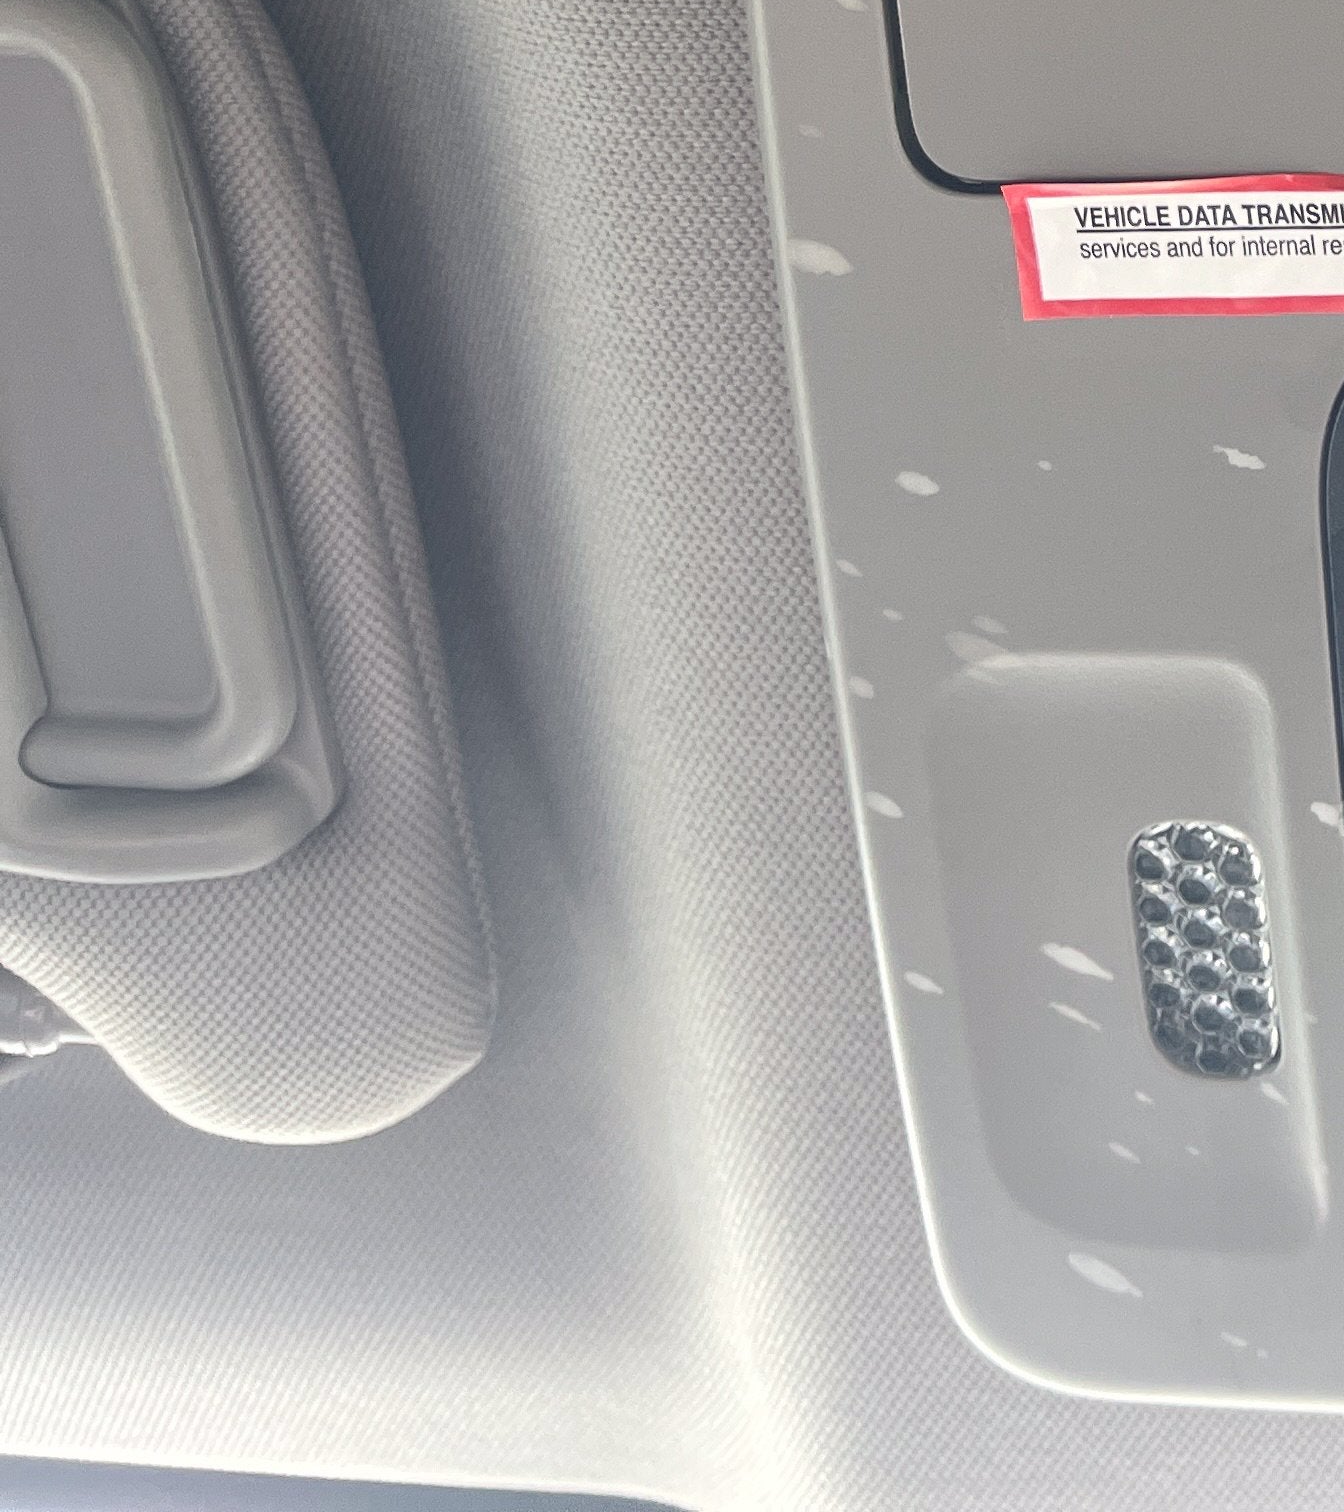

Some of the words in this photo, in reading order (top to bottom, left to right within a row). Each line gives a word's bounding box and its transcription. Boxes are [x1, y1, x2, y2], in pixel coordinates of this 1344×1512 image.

[1074, 205, 1172, 229] VEHICLE
[1178, 205, 1236, 227] DATA
[1080, 239, 1161, 259] services
[1167, 236, 1203, 258] and
[1208, 236, 1236, 256] for
[1242, 234, 1316, 255] internal
